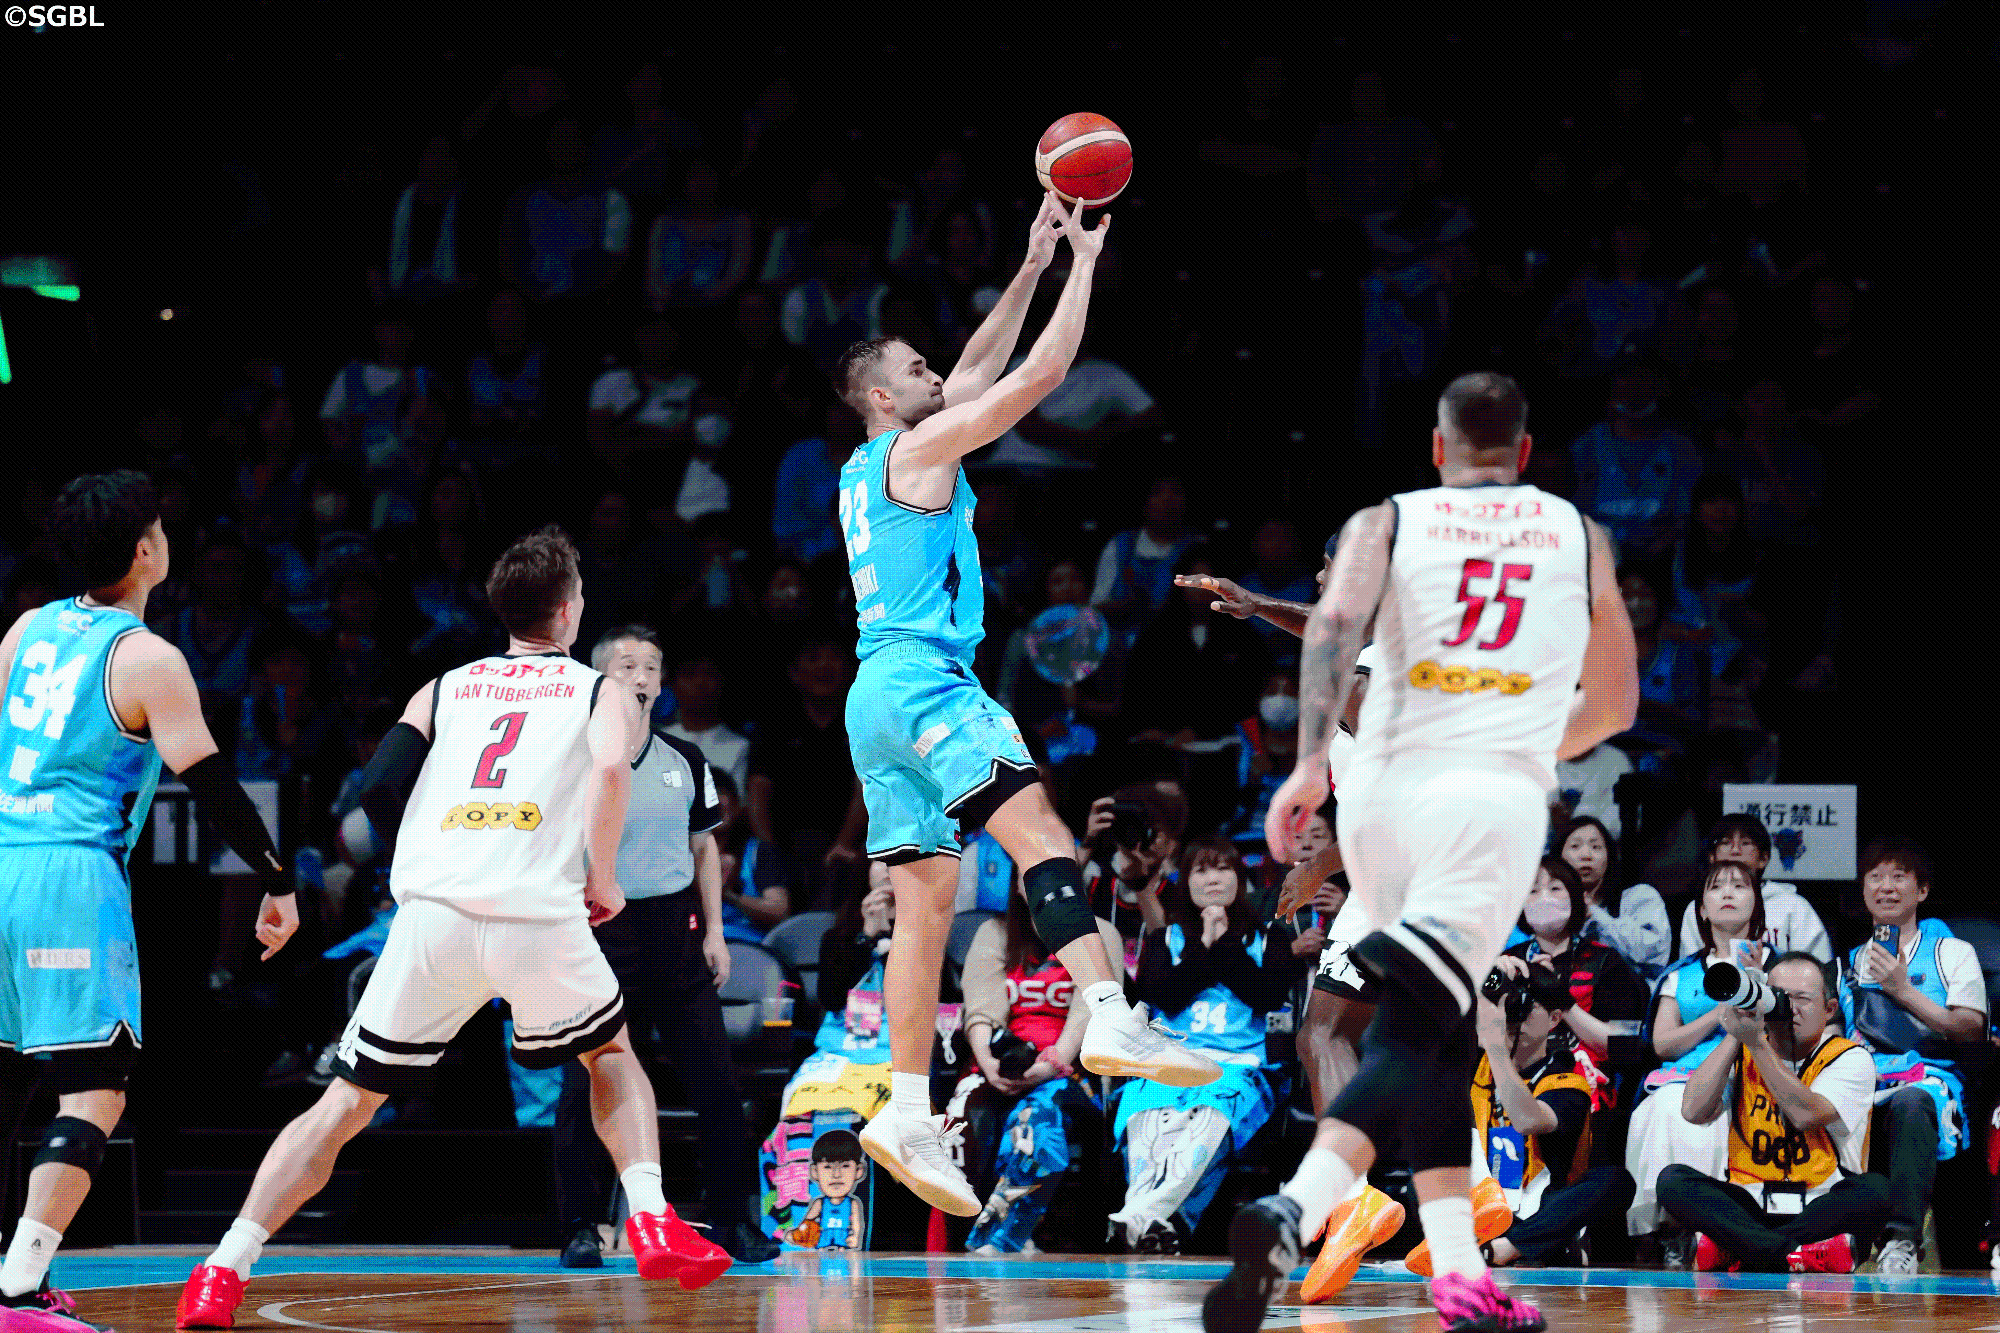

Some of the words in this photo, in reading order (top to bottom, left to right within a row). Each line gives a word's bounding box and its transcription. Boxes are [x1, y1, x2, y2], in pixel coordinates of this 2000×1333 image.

[839, 478, 871, 562] 23
[1440, 558, 1534, 650] 55
[8, 640, 88, 740] 34
[469, 664, 568, 679] ロックアイス
[486, 683, 575, 702] TUBBERGEN
[470, 711, 529, 788] 2
[446, 807, 537, 826] TOPY
[1191, 1001, 1227, 1033] 34
